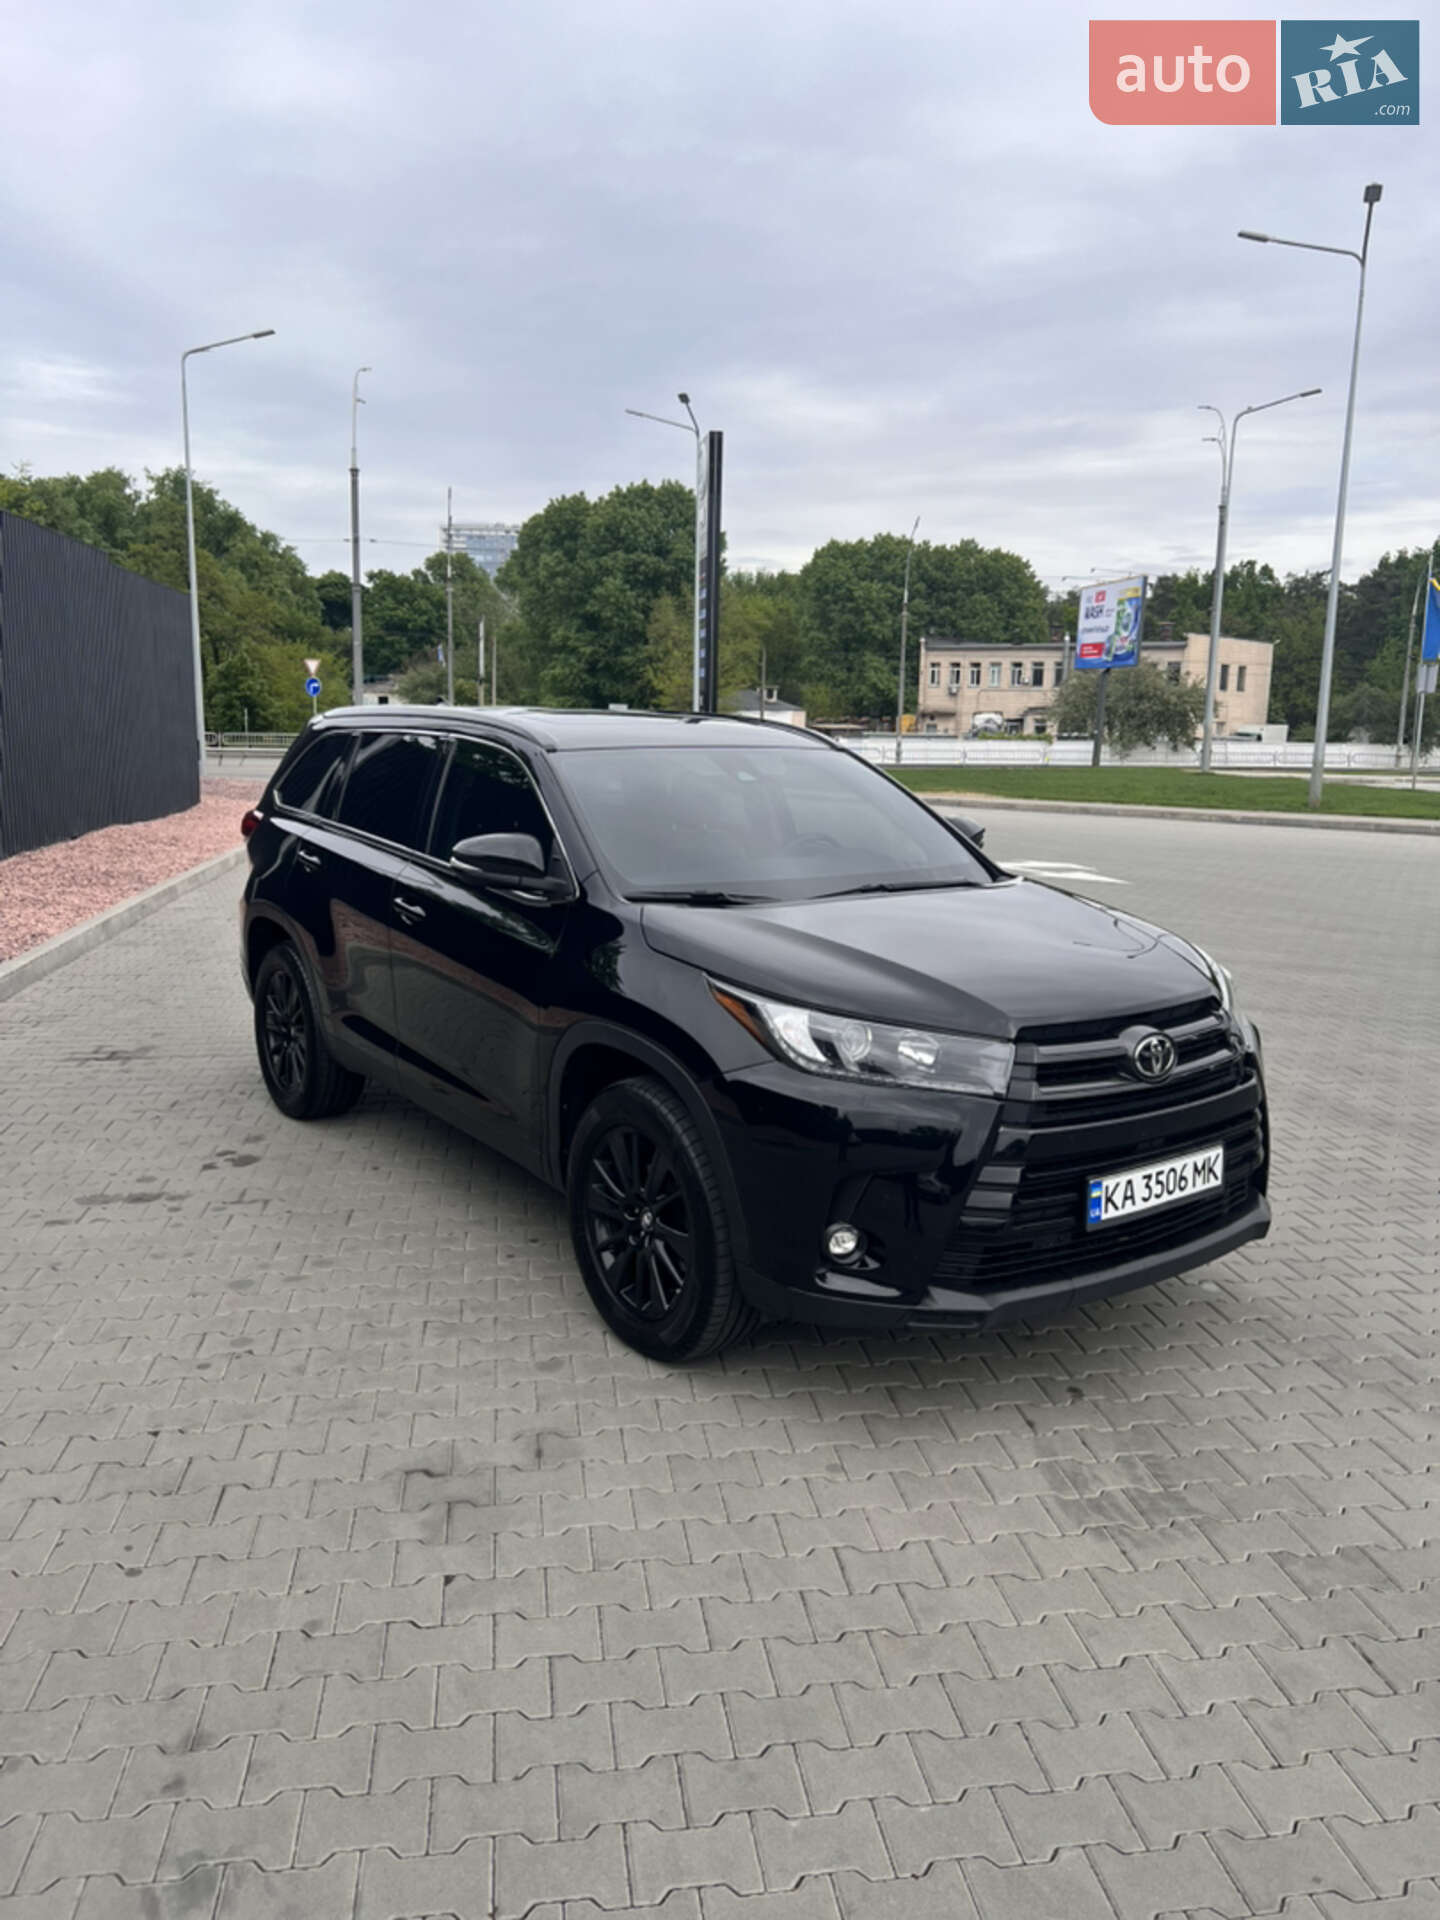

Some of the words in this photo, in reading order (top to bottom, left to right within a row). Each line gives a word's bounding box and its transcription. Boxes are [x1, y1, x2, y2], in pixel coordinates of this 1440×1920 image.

[1103, 1178, 1136, 1214] KA
[1141, 1163, 1189, 1203] 3506
[1192, 1153, 1221, 1189] MK
